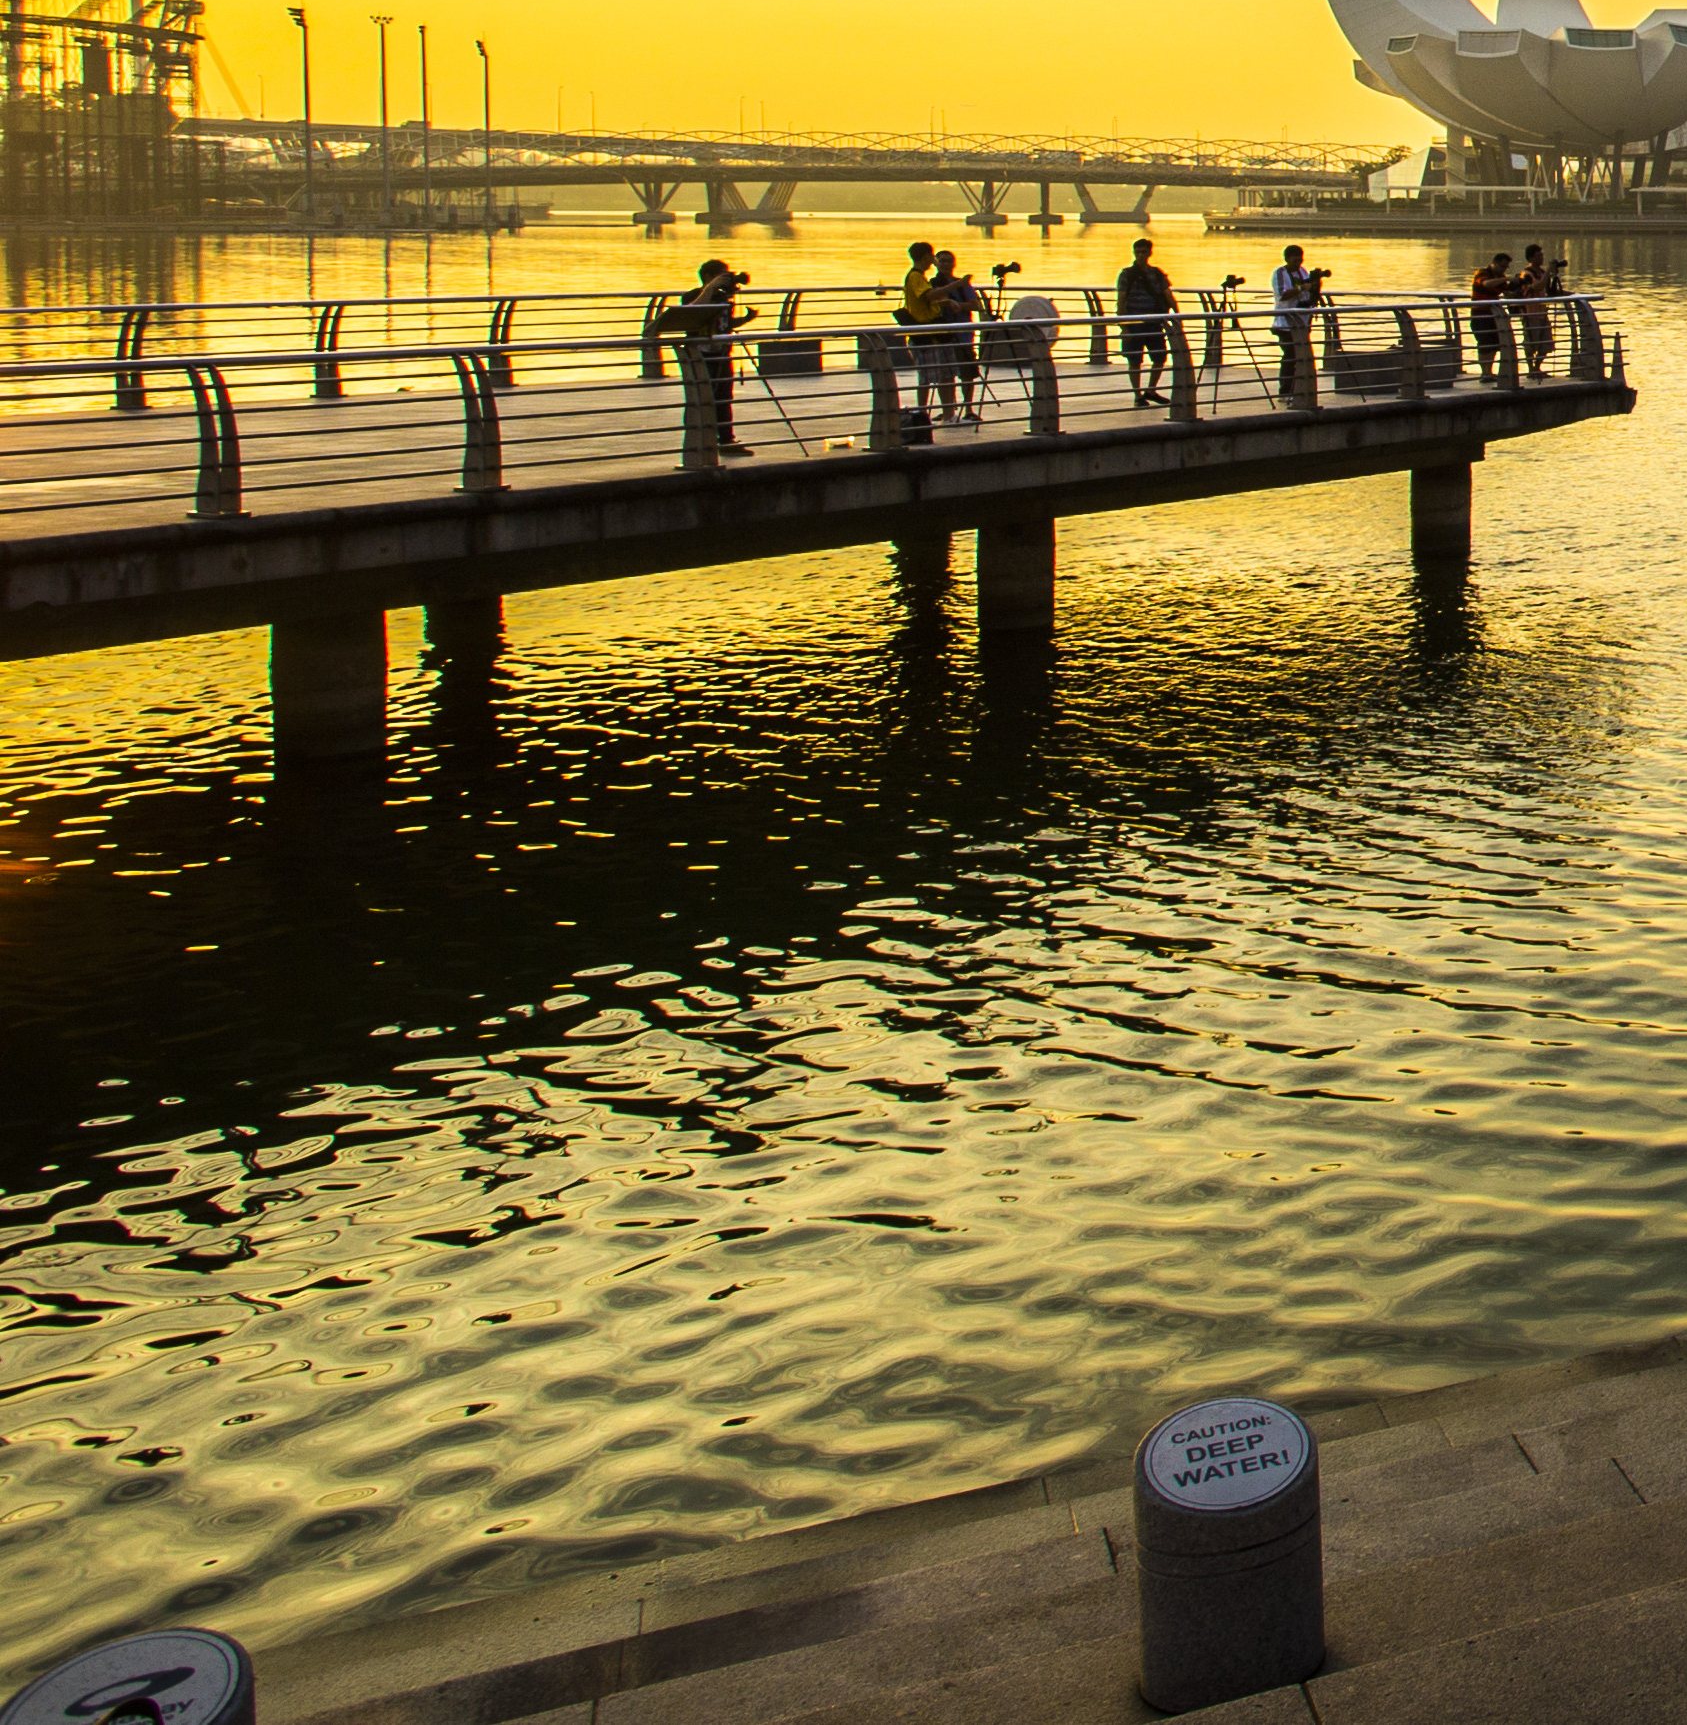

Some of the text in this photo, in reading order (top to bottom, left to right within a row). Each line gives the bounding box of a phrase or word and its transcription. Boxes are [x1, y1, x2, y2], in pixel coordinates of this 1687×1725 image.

[1171, 1415, 1271, 1444] CAUTION:
[1186, 1433, 1264, 1464] DEEP
[1173, 1449, 1290, 1488] WATER!
